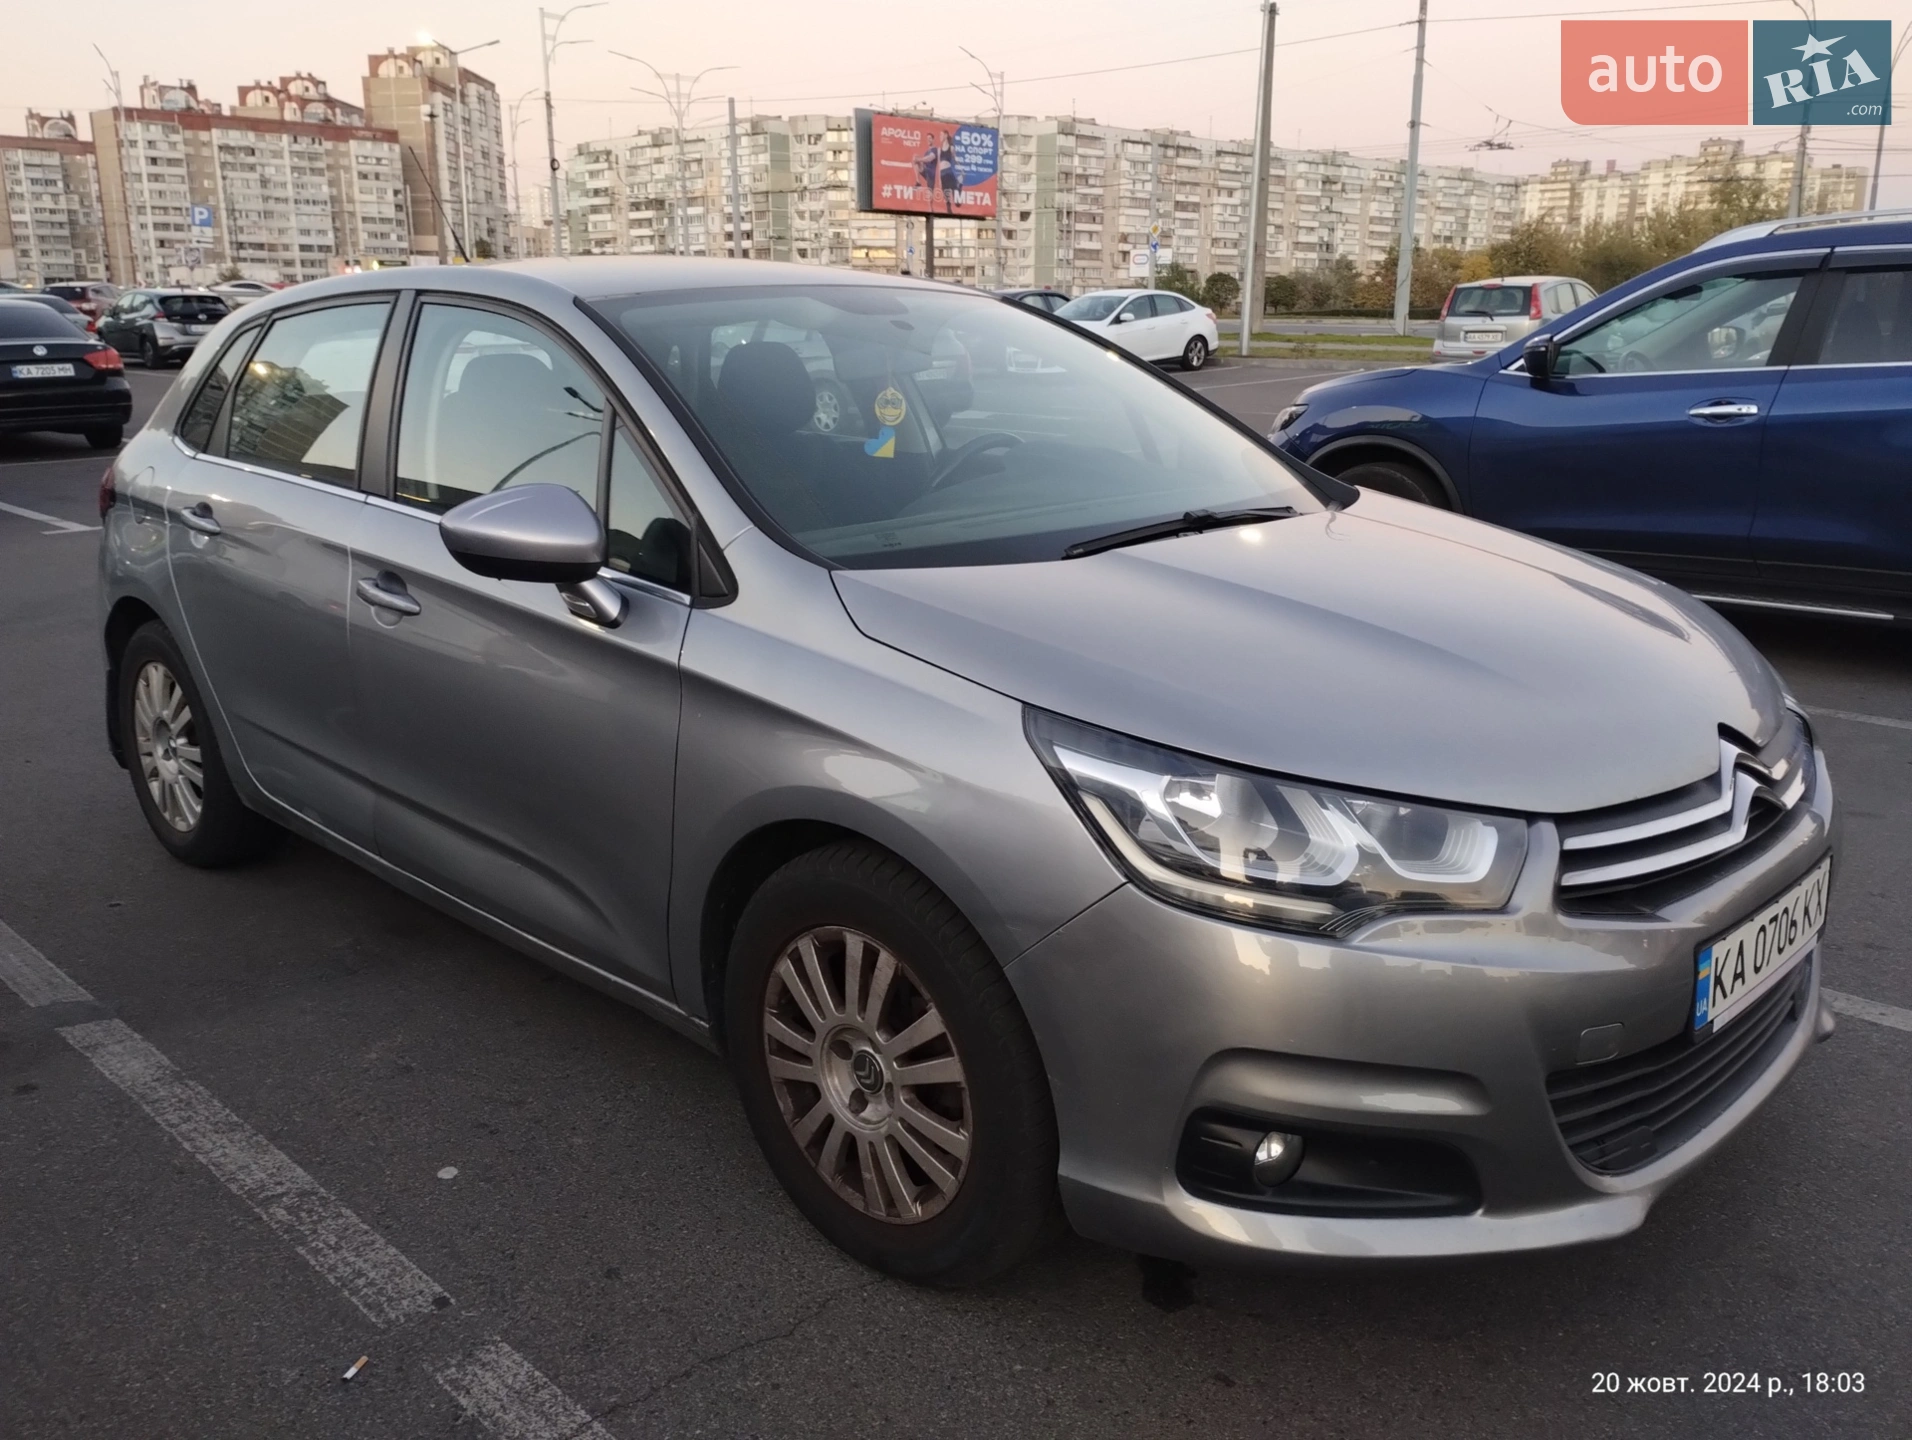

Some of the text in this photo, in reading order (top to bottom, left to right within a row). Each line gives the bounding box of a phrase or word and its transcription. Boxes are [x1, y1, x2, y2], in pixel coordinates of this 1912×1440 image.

[881, 126, 921, 140] APOLLO
[954, 131, 994, 148] -50%
[902, 139, 921, 147] NEXT
[967, 146, 993, 155] СПОРТ
[964, 154, 983, 164] 299
[1712, 871, 1827, 1008] KA 0706 KX
[1696, 997, 1707, 1017] UA
